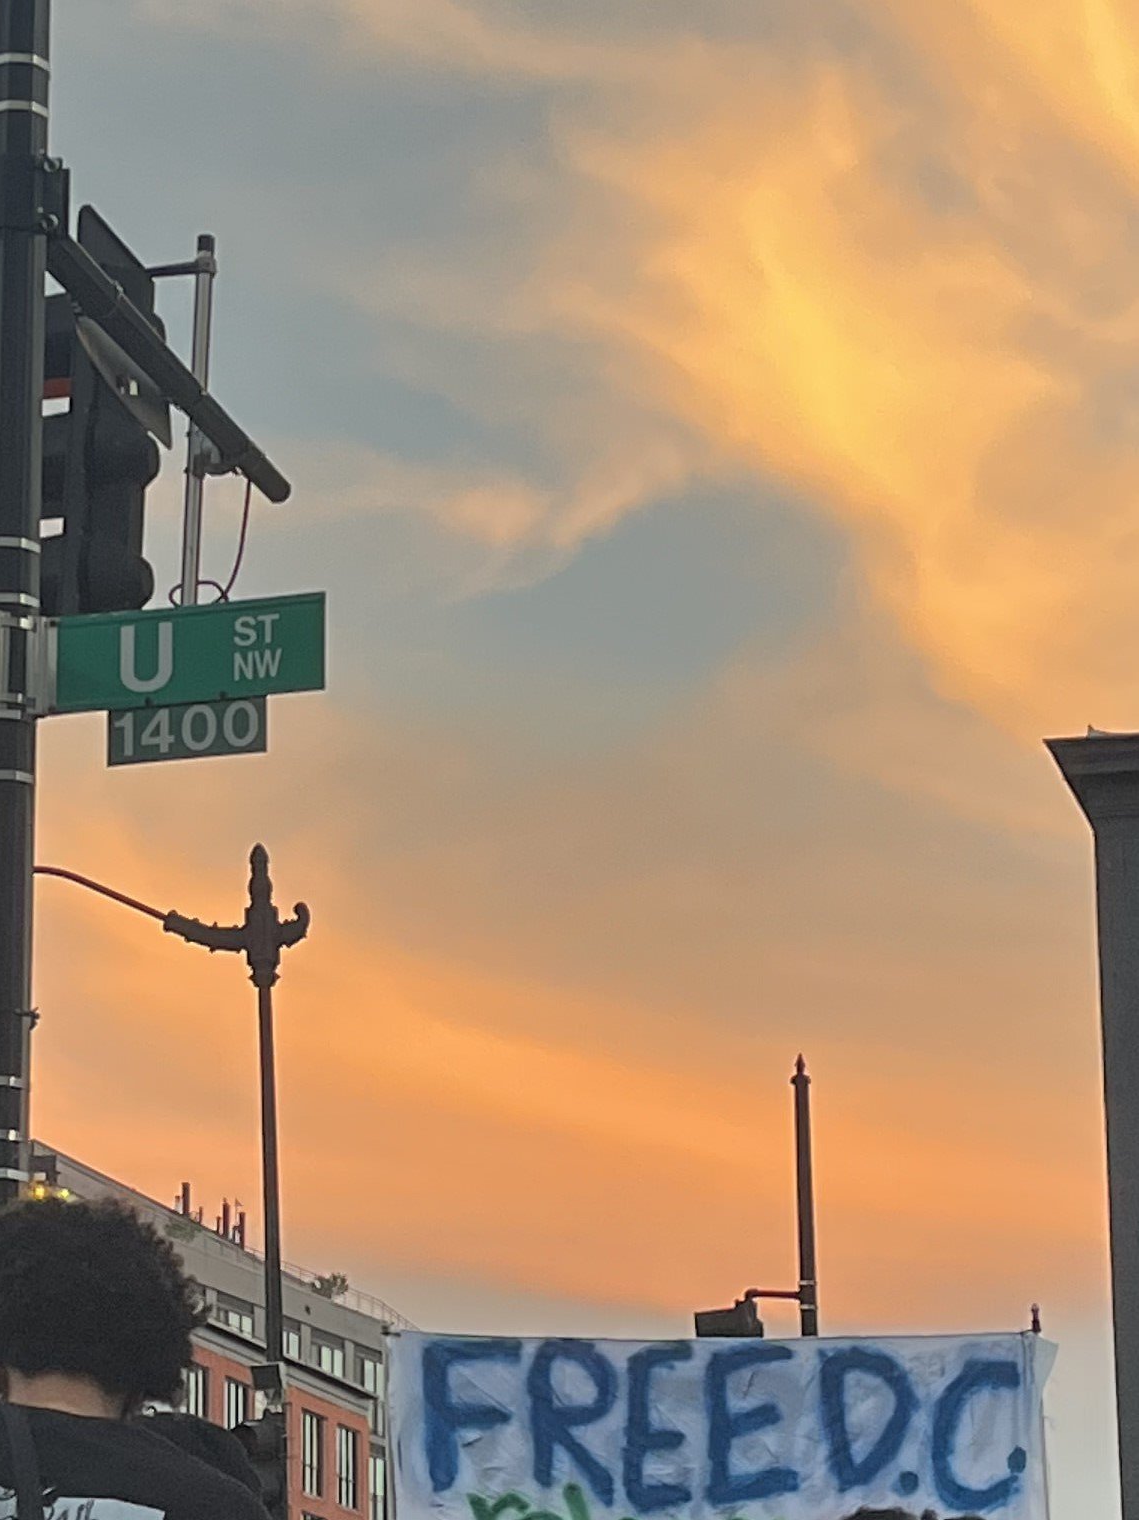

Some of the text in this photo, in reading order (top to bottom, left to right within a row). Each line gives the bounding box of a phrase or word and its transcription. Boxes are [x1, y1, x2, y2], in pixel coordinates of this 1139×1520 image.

[120, 613, 280, 693] U ST
[233, 648, 282, 682] NW
[114, 699, 259, 757] 1400
[421, 1339, 798, 1512] FREE
